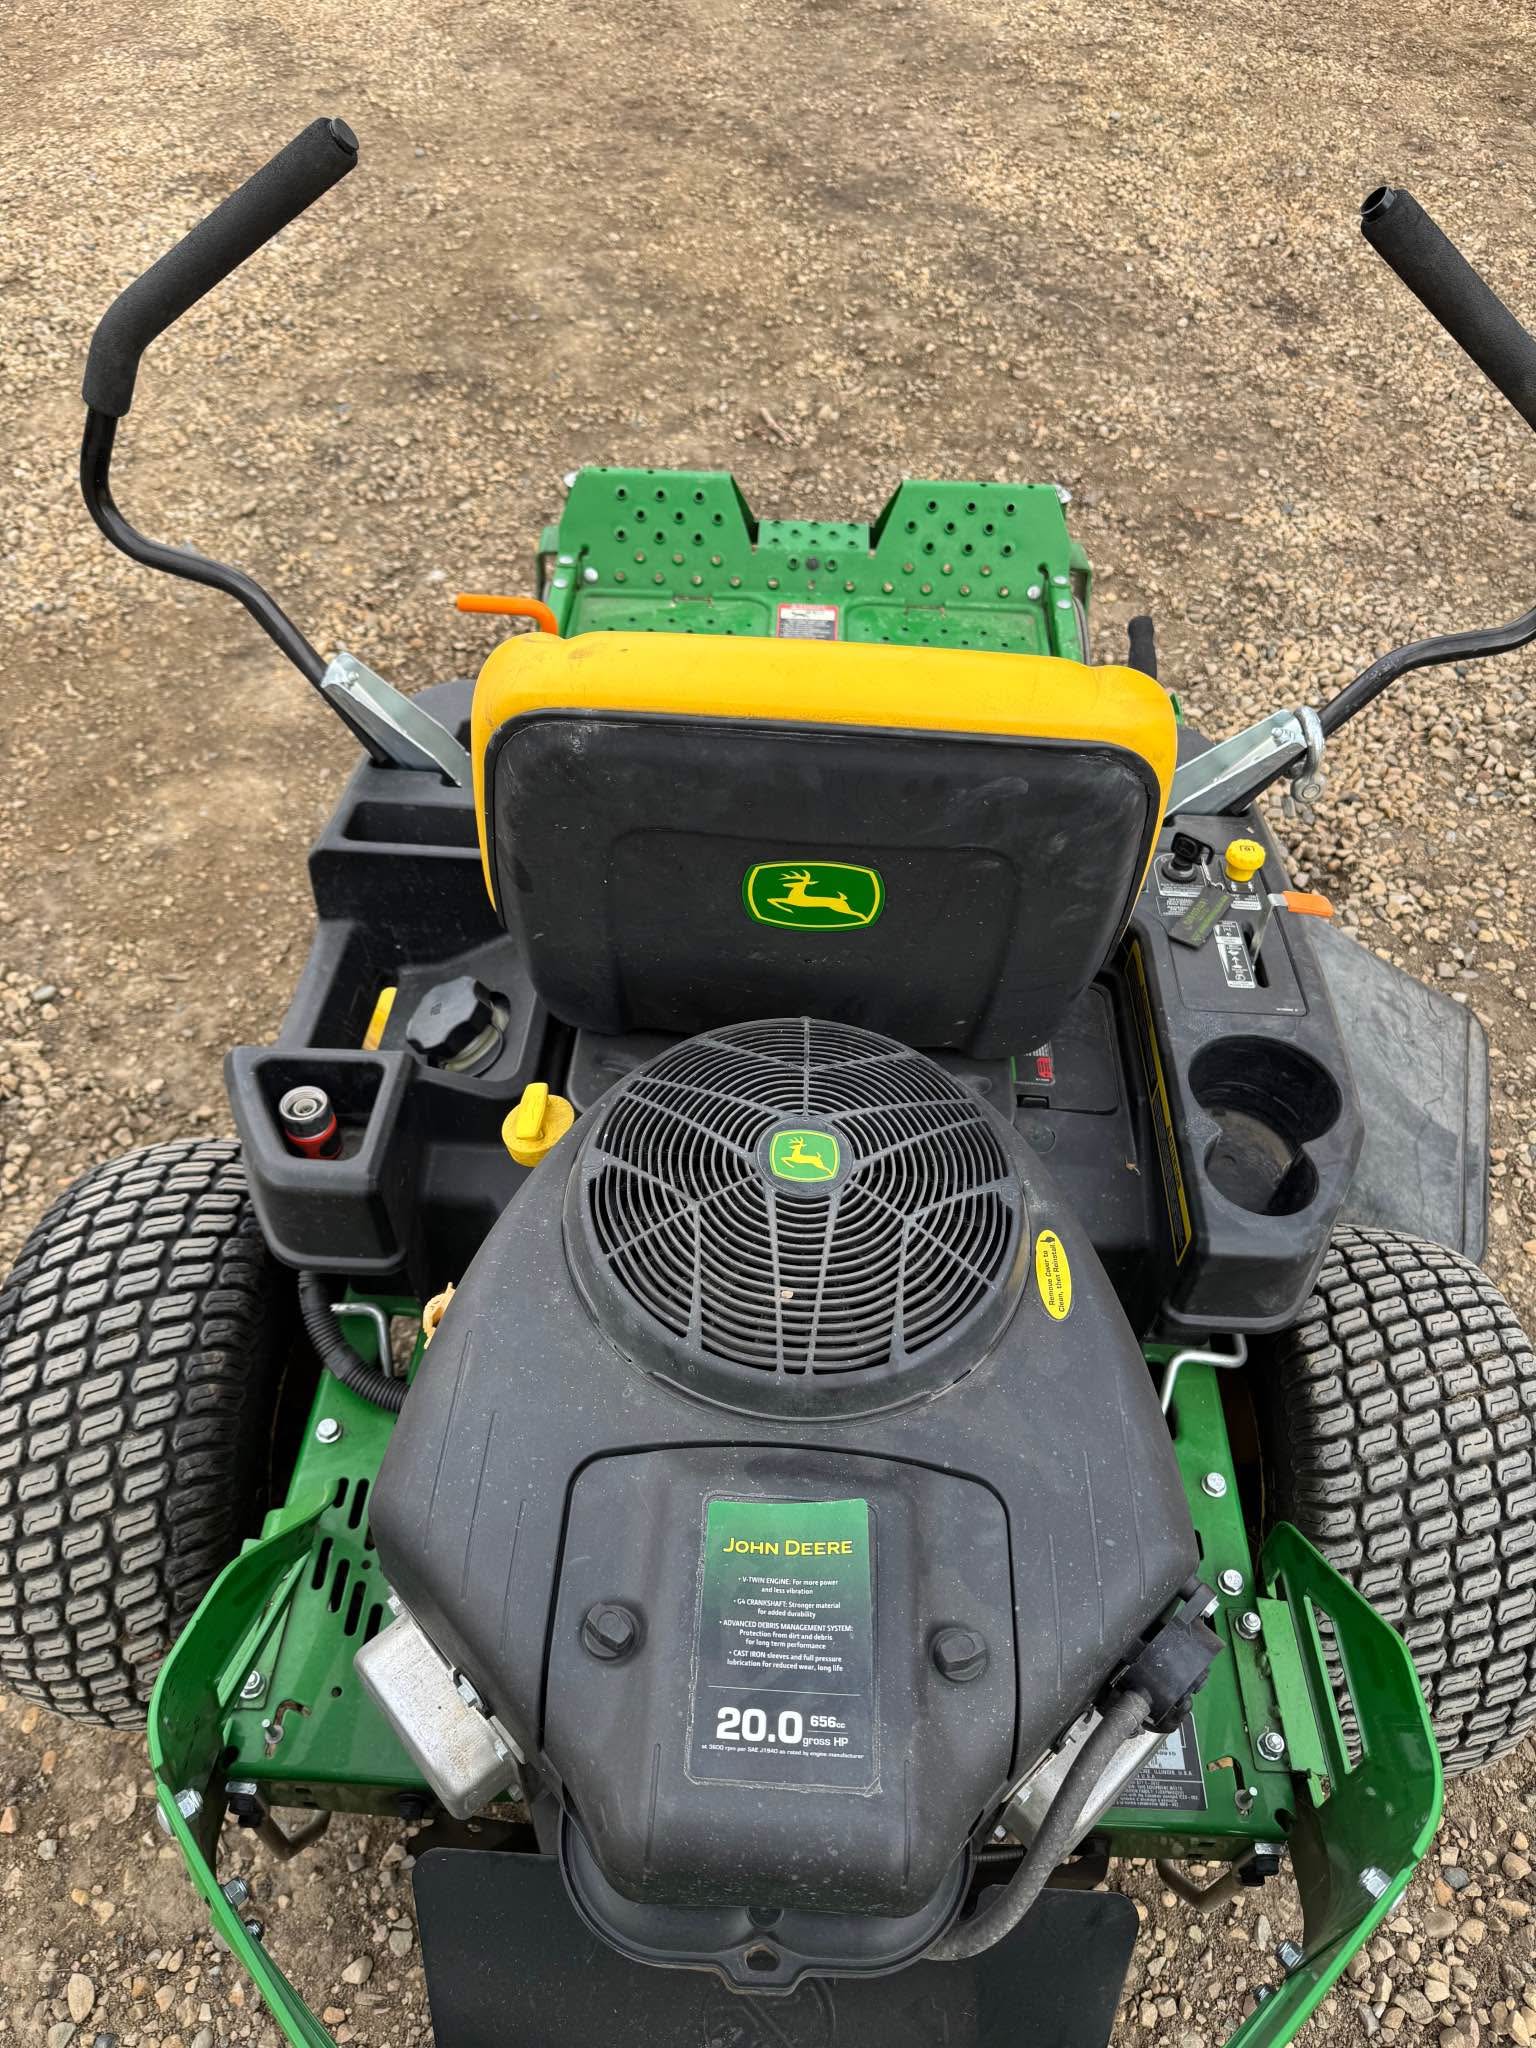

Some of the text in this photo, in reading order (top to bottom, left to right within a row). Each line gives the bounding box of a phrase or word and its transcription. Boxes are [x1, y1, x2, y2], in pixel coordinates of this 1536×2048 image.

[723, 1537, 853, 1556] JOHN DEERE
[747, 1599, 787, 1607] CRANKSHAFT:
[789, 1602, 814, 1610] Stronger
[787, 1611, 816, 1619] durability
[756, 1639, 769, 1647] long
[727, 1659, 761, 1667] lubrication
[817, 1663, 831, 1673] long
[716, 1706, 848, 1747] 20.0 gross HP
